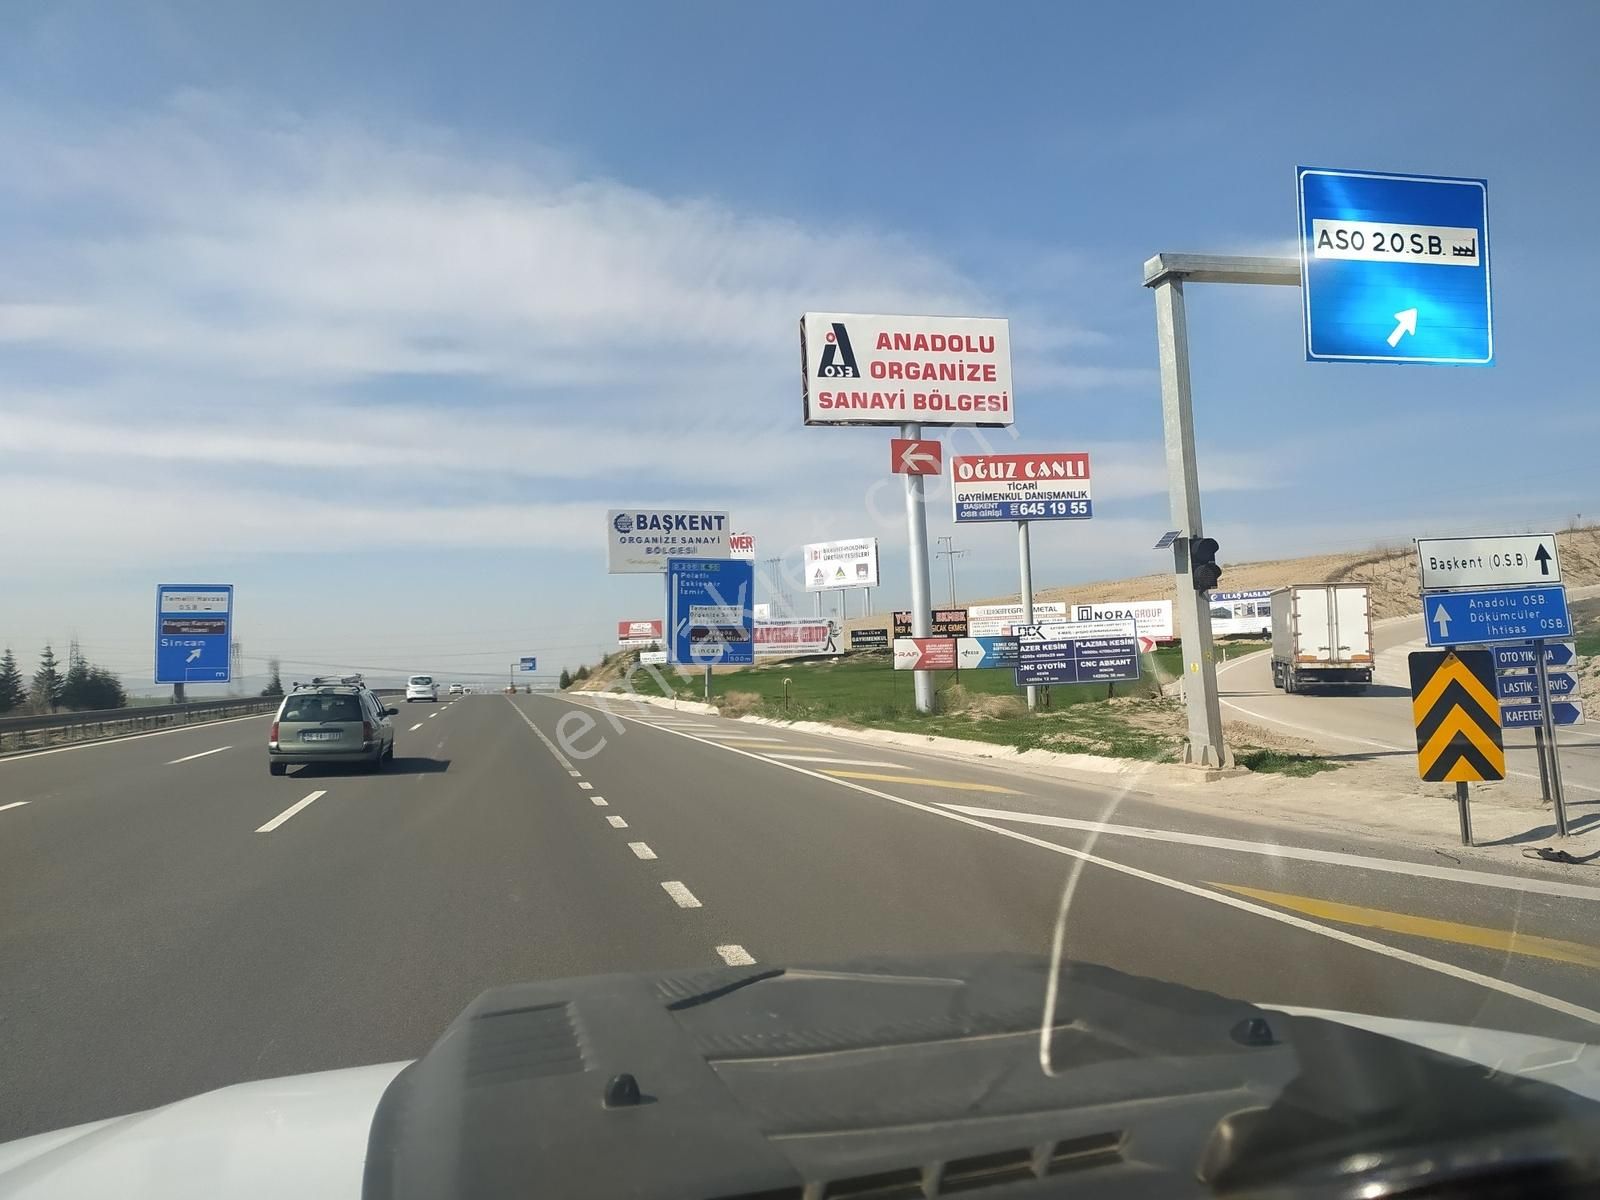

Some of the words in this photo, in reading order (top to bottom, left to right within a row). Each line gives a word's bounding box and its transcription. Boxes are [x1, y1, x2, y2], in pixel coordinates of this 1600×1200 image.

[1317, 229, 1365, 251] ASO
[876, 332, 995, 354] ANADOLU
[870, 359, 997, 382] ORGANİZE
[818, 388, 906, 410] SANAYİ
[912, 388, 1009, 412] BÖLGESİ
[958, 458, 1018, 480] OĞUZ
[1024, 460, 1086, 479] CANLI
[1007, 481, 1038, 491] TİCARİ
[957, 490, 1022, 502] GAYRİMENKUL
[1024, 490, 1089, 501] DANIŞMANLIK
[963, 502, 999, 510] BAŞKENT
[1019, 503, 1045, 516] 645
[1050, 502, 1067, 515] 19
[1070, 501, 1088, 515] 55
[636, 514, 726, 534] BAŞKENT
[619, 535, 677, 545] ORGANİZE
[680, 536, 721, 545] SANAYİ
[1429, 556, 1483, 572] Başkent
[680, 587, 705, 595] İzmir
[1222, 592, 1242, 600] ULAŞ
[1033, 605, 1058, 613] METAL
[1469, 598, 1517, 609] Anadolu
[1095, 609, 1134, 620] NORA
[1134, 608, 1163, 619] GROUP
[1470, 610, 1541, 623] Dökümcüler
[1487, 622, 1528, 636] İhtisas
[160, 638, 207, 647] Sincan
[1020, 644, 1040, 652] AZER
[1042, 641, 1068, 651] KESİM
[1075, 640, 1108, 648] PLAZMA
[1109, 638, 1135, 647] KESİM
[1080, 660, 1098, 668] CNC
[1099, 658, 1132, 667] ABKANT
[1500, 651, 1519, 663] OTO
[1020, 663, 1035, 672] CNC
[1036, 661, 1067, 670] GYOTİN
[1503, 680, 1533, 694] LASTİK
[1549, 677, 1569, 691] RVİS
